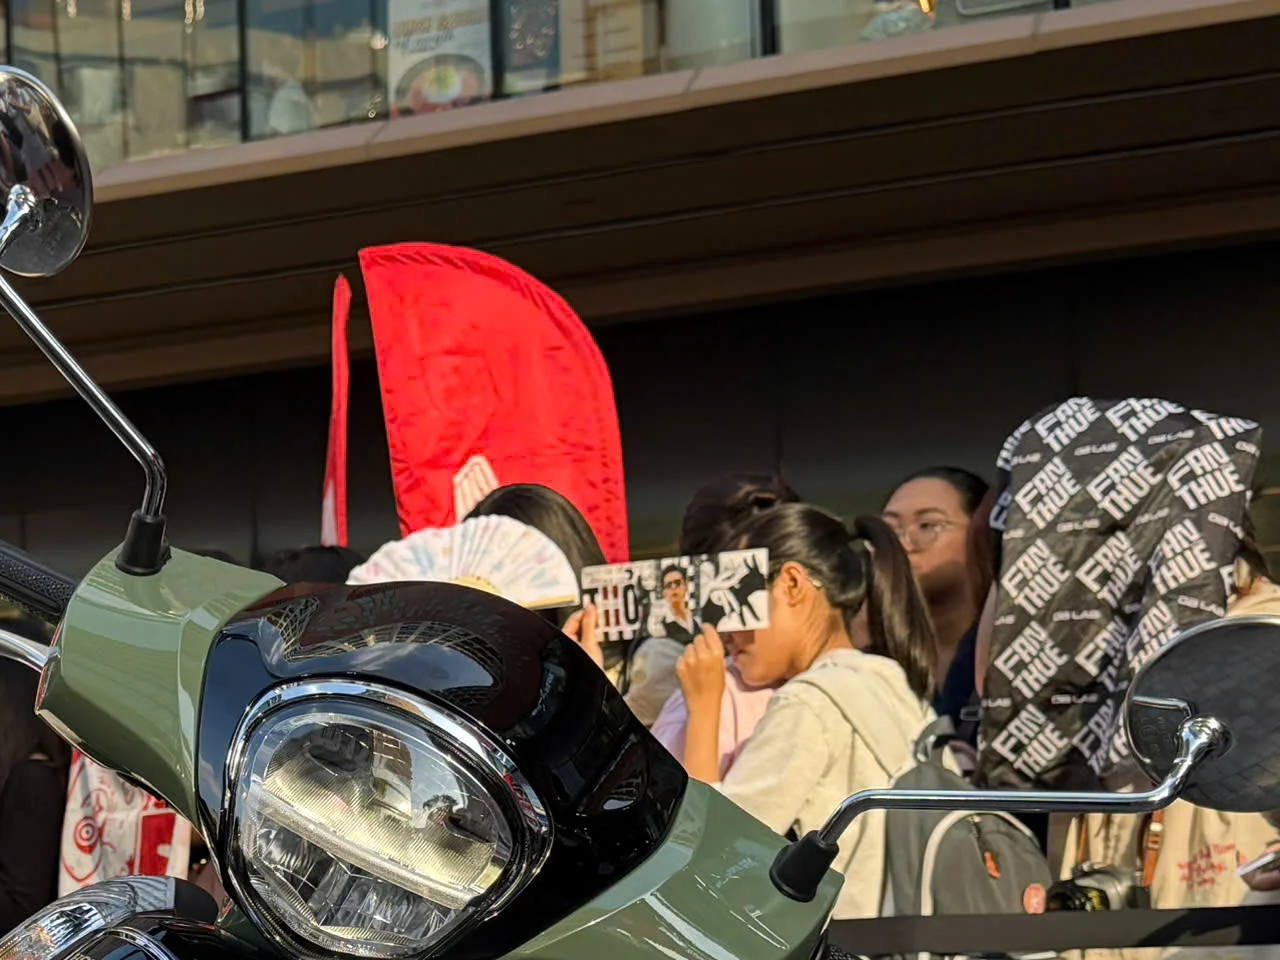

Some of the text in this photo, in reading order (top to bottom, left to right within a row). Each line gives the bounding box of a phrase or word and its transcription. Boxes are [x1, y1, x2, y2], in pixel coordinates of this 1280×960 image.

[1043, 402, 1102, 453] THUE
[1014, 456, 1069, 514] FAN
[1086, 445, 1146, 503] FAN
[1097, 461, 1164, 521] THUE
[1166, 441, 1231, 490] FAN
[1175, 464, 1246, 510] THUE
[1026, 471, 1082, 529] THUE
[1001, 538, 1051, 598] FAN
[1015, 556, 1070, 616] THUE
[1075, 531, 1131, 593] FAN
[1096, 546, 1142, 608] THUE
[1153, 539, 1218, 595] THUE
[994, 620, 1048, 680] FAN
[1010, 637, 1069, 699] THUE
[991, 703, 1048, 762] FAN
[1013, 720, 1069, 779] THUE
